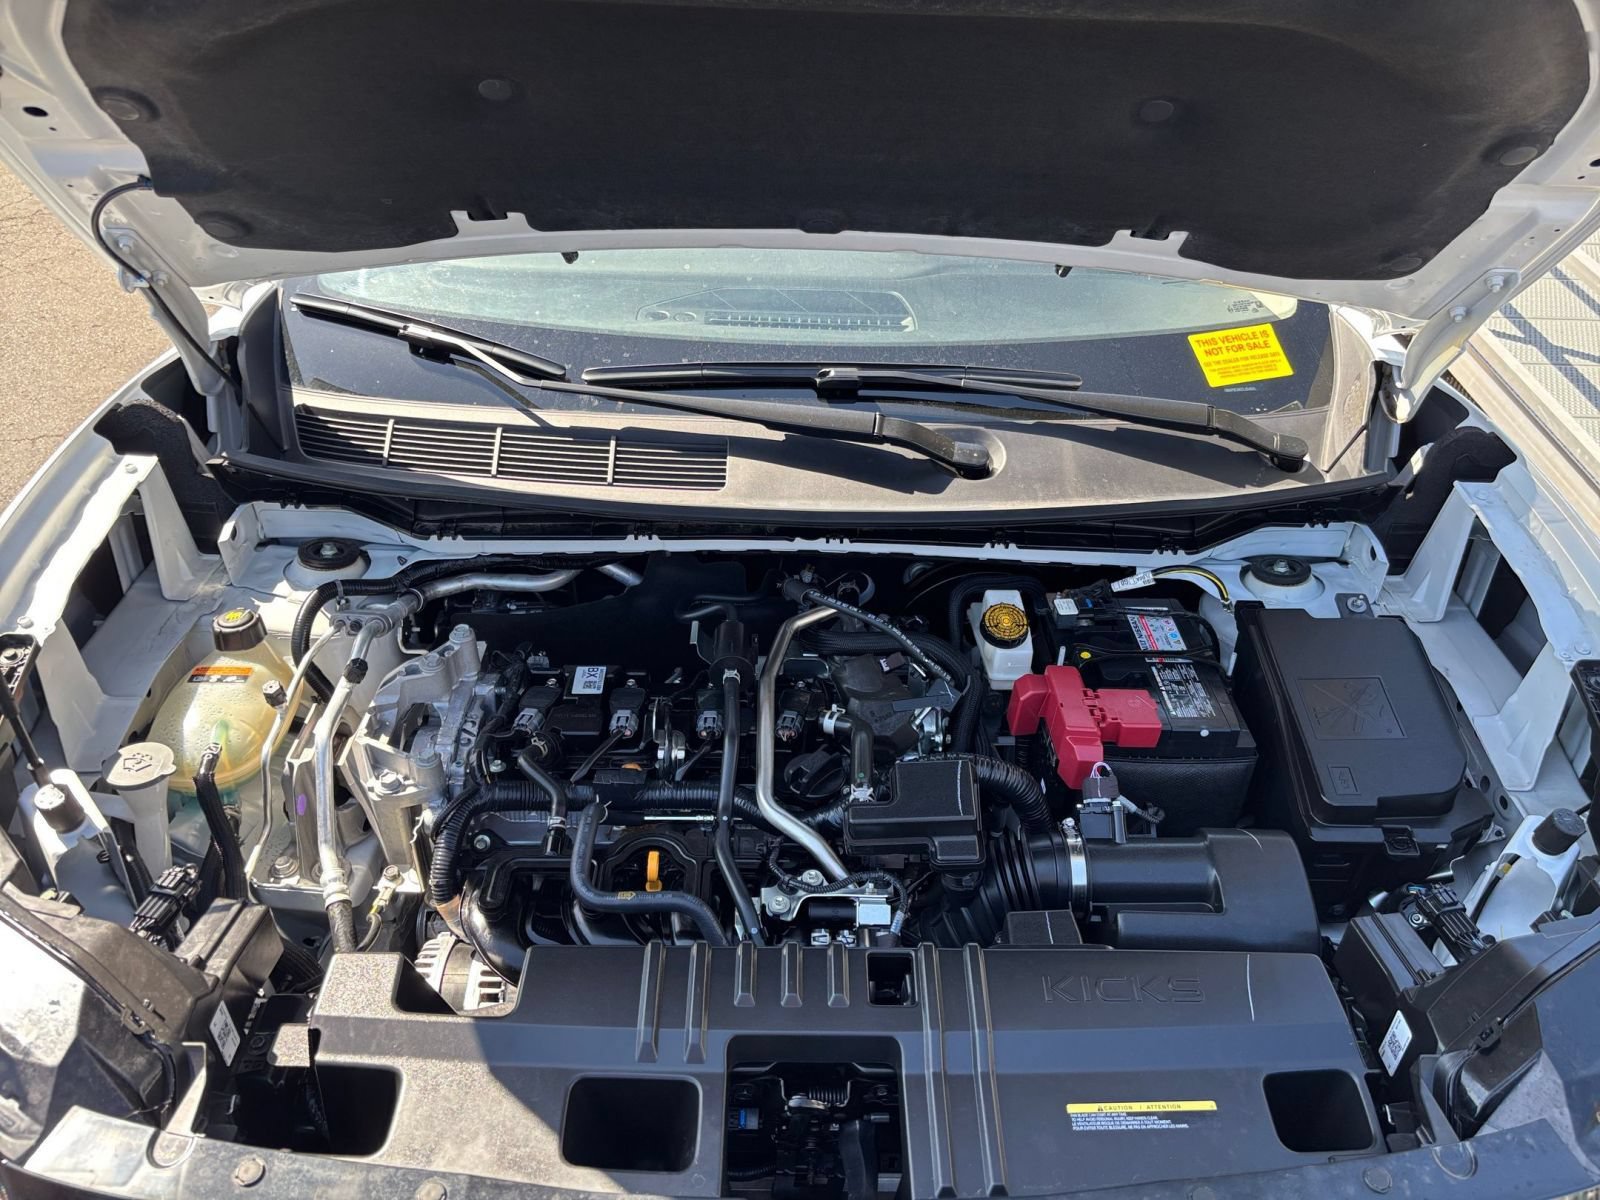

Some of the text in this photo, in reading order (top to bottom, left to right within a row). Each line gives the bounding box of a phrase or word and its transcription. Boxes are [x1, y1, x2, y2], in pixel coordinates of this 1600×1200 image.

[1195, 329, 1270, 348] THIS VEHICLE IS
[1204, 340, 1271, 357] NOT FOR SALE
[586, 667, 599, 679] BX
[1041, 975, 1206, 1003] KICKS
